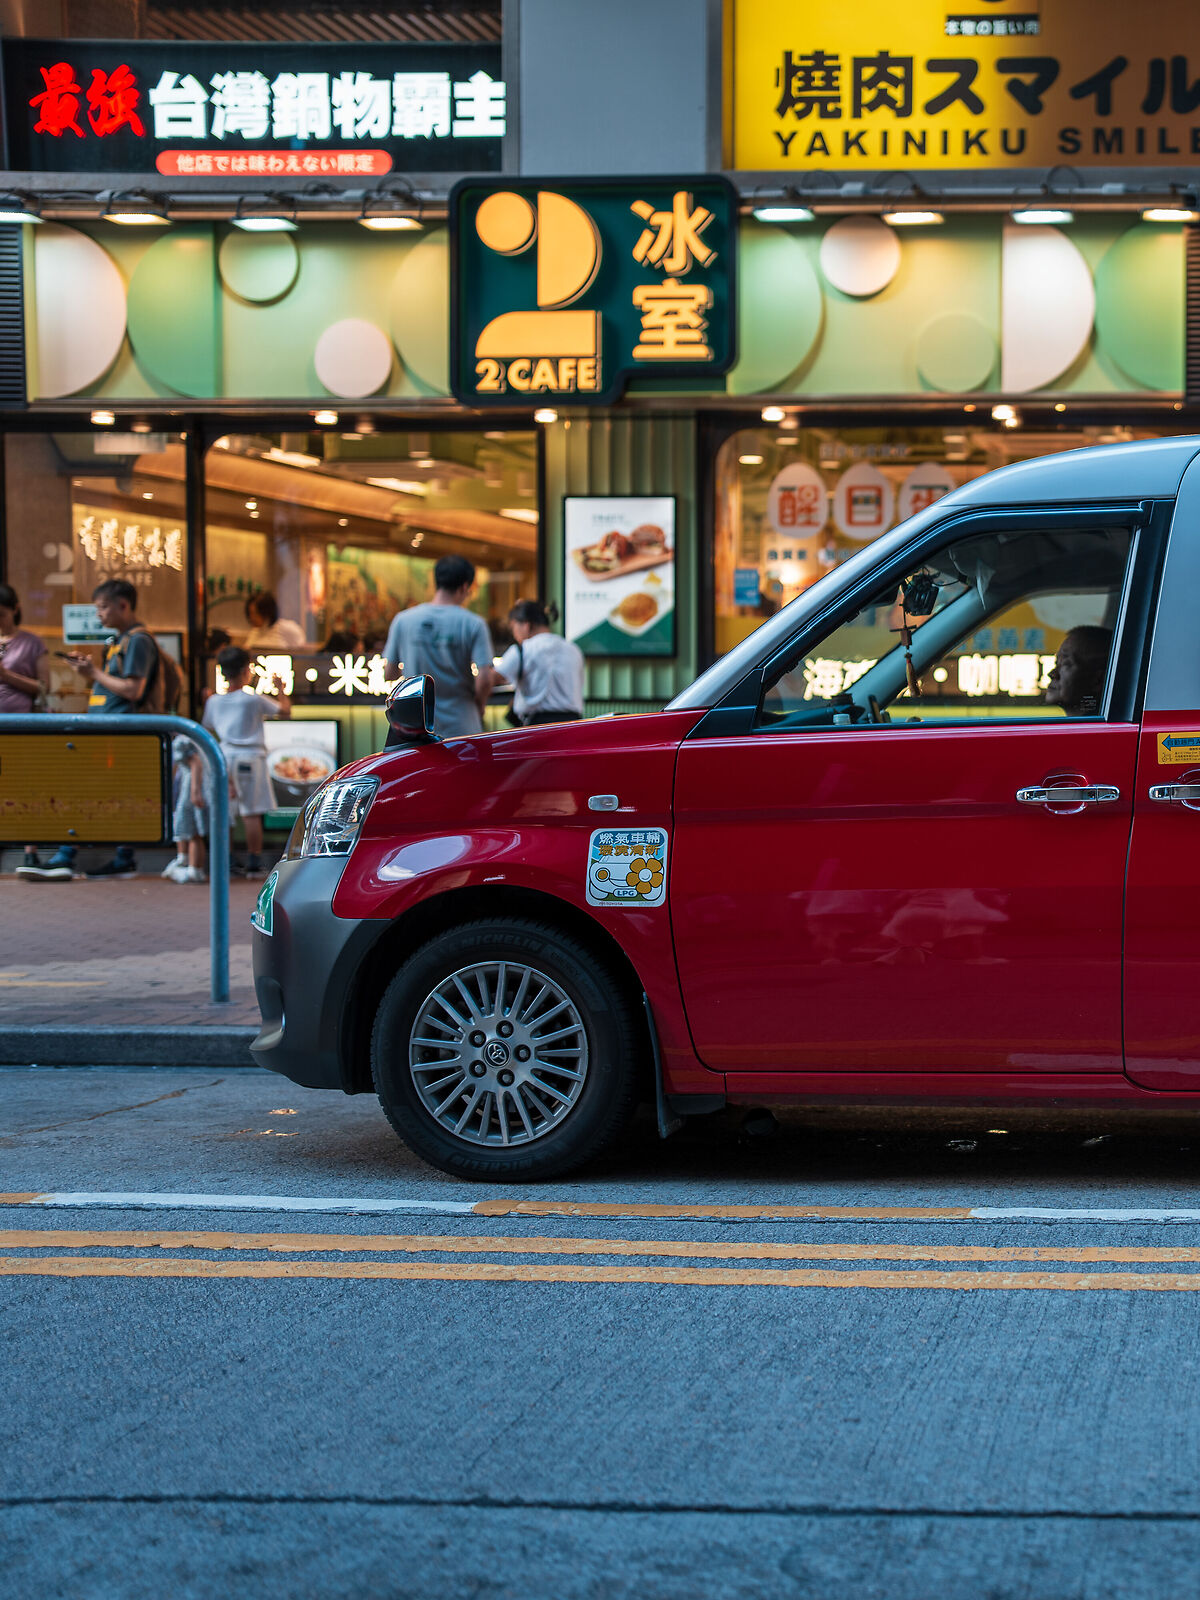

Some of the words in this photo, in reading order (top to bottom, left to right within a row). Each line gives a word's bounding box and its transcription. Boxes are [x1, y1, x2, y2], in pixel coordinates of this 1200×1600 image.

[773, 129, 1027, 157] YAKINIKU
[630, 190, 717, 362] 冰室
[507, 358, 598, 394] CAFE
